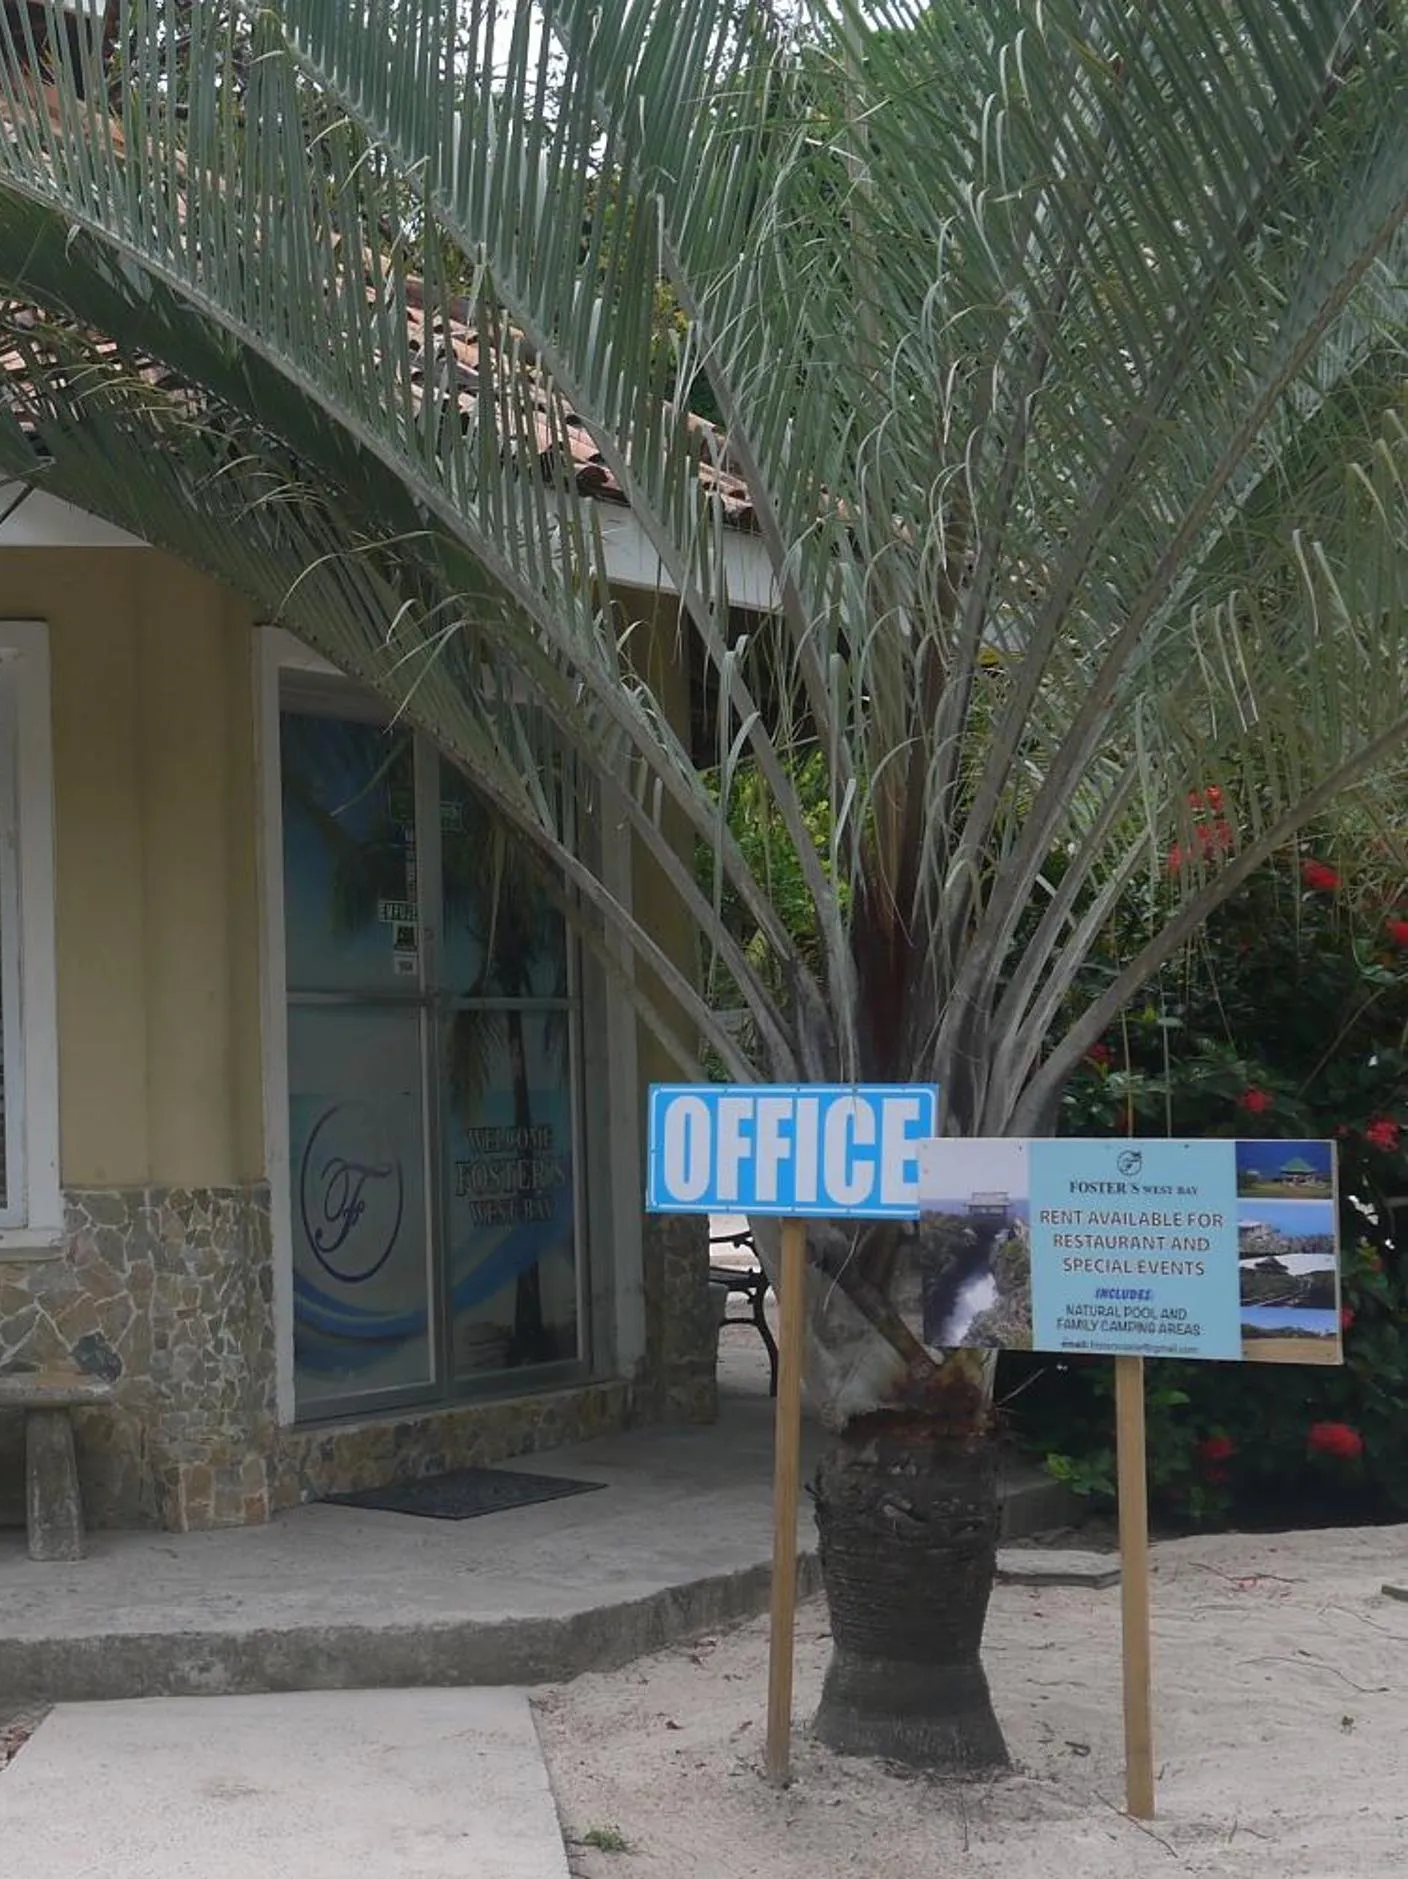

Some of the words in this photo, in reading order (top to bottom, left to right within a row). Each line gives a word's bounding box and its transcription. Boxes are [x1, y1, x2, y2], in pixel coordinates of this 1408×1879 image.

[664, 1095, 920, 1205] OFFICE
[1143, 1185, 1173, 1195] WEST
[1176, 1185, 1199, 1195] BAY
[1039, 1209, 1083, 1226] RENT
[1087, 1210, 1184, 1228] AVAILABLE
[1187, 1212, 1224, 1229] FOR
[1053, 1232, 1166, 1251] RESTAURANT
[1170, 1236, 1211, 1252] AND
[1063, 1256, 1134, 1274] SPECIAL
[1137, 1259, 1205, 1276] EVENTS
[1065, 1303, 1121, 1318] NATURAL
[1124, 1305, 1157, 1320] POOL
[1159, 1308, 1188, 1321] AND
[1056, 1317, 1098, 1332] FAMILY
[1099, 1319, 1156, 1335] CAMPING
[1157, 1323, 1201, 1337] AREAS
